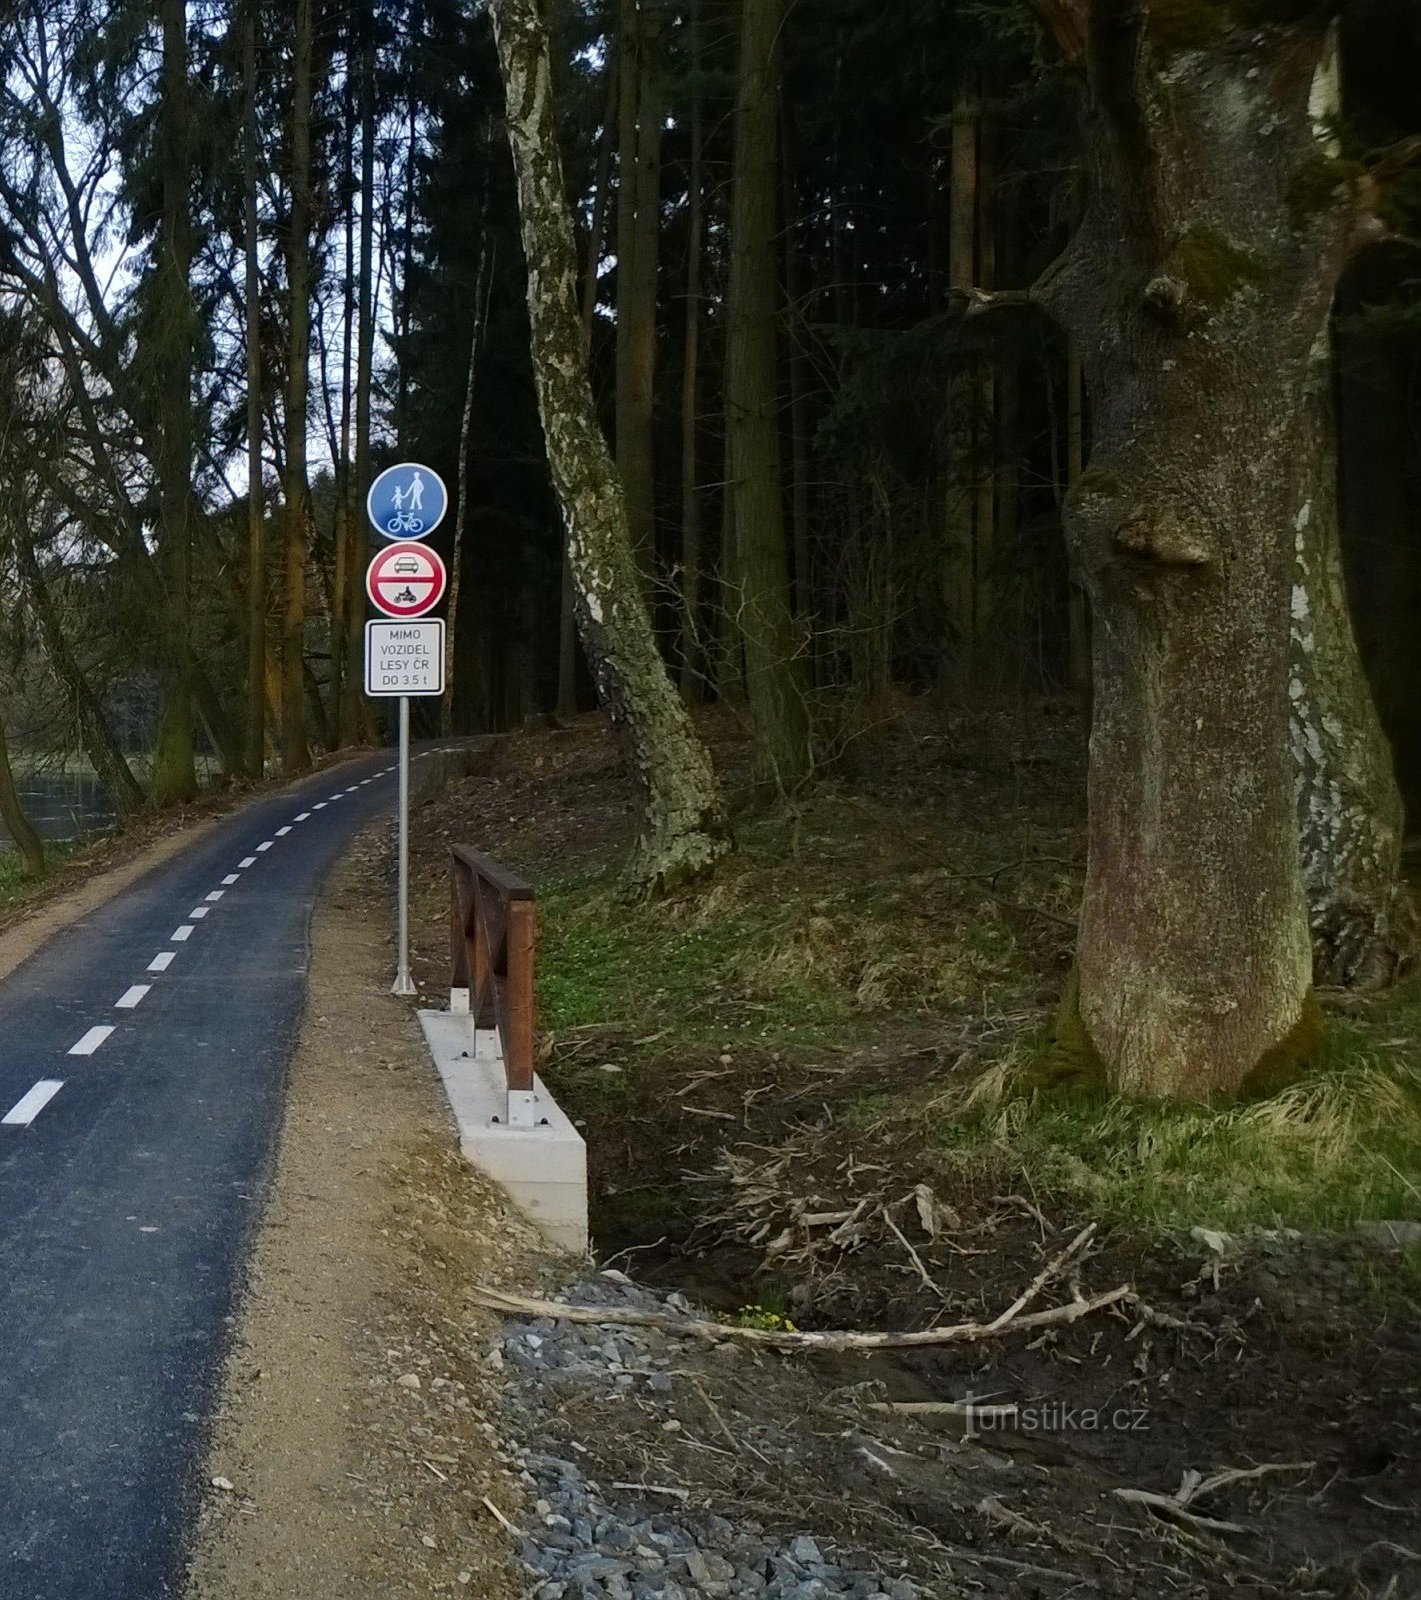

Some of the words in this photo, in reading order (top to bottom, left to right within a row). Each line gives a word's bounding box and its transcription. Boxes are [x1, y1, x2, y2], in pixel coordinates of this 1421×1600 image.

[390, 629, 421, 640] MIMO
[380, 644, 430, 655] VOZIDEL
[380, 660, 409, 670] LESY
[413, 656, 429, 669] ČR
[382, 675, 398, 685] DO
